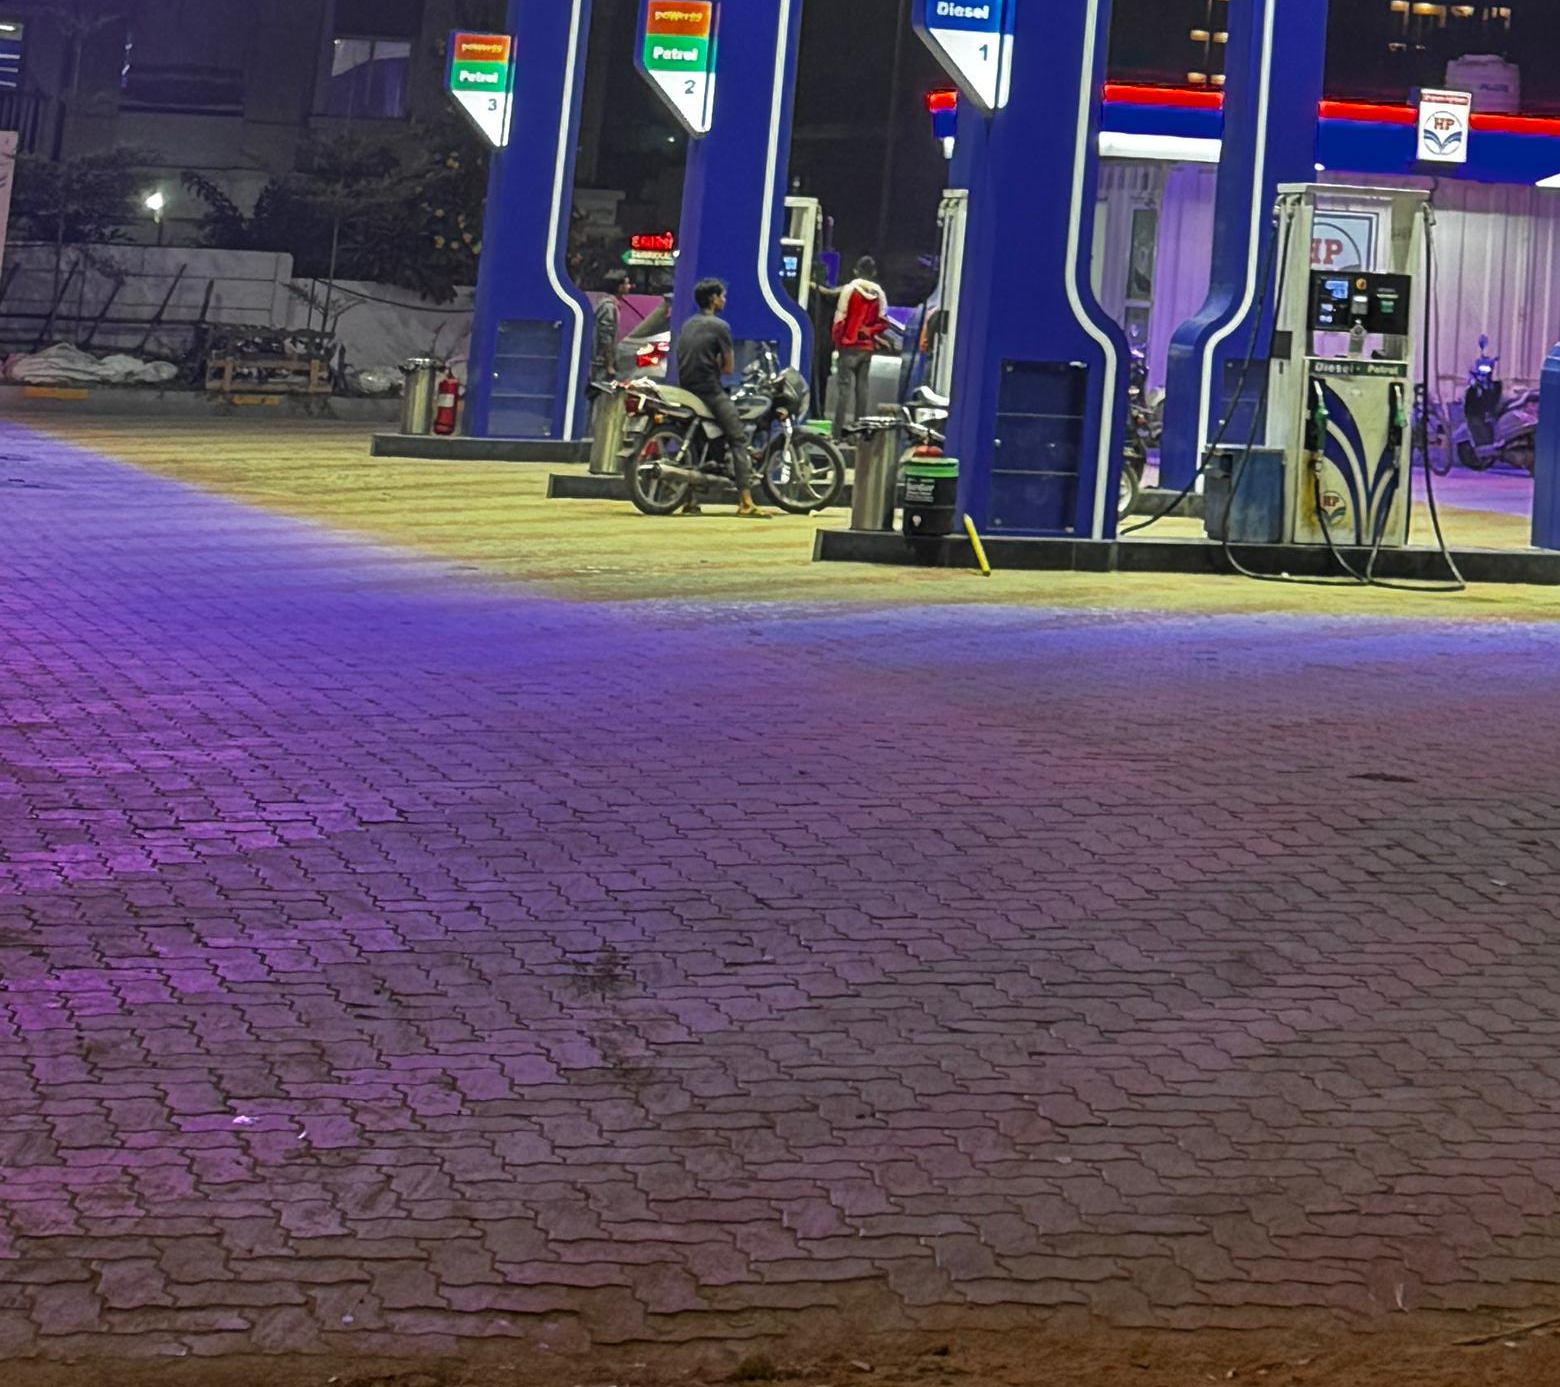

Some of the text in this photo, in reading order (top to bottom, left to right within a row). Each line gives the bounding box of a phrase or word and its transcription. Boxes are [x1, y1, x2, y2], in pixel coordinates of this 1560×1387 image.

[936, 1, 990, 20] Diesel
[652, 45, 699, 62] Petrol
[979, 43, 989, 61] 1
[684, 79, 696, 94] 2
[487, 98, 498, 111] 3
[1434, 117, 1456, 131] HP
